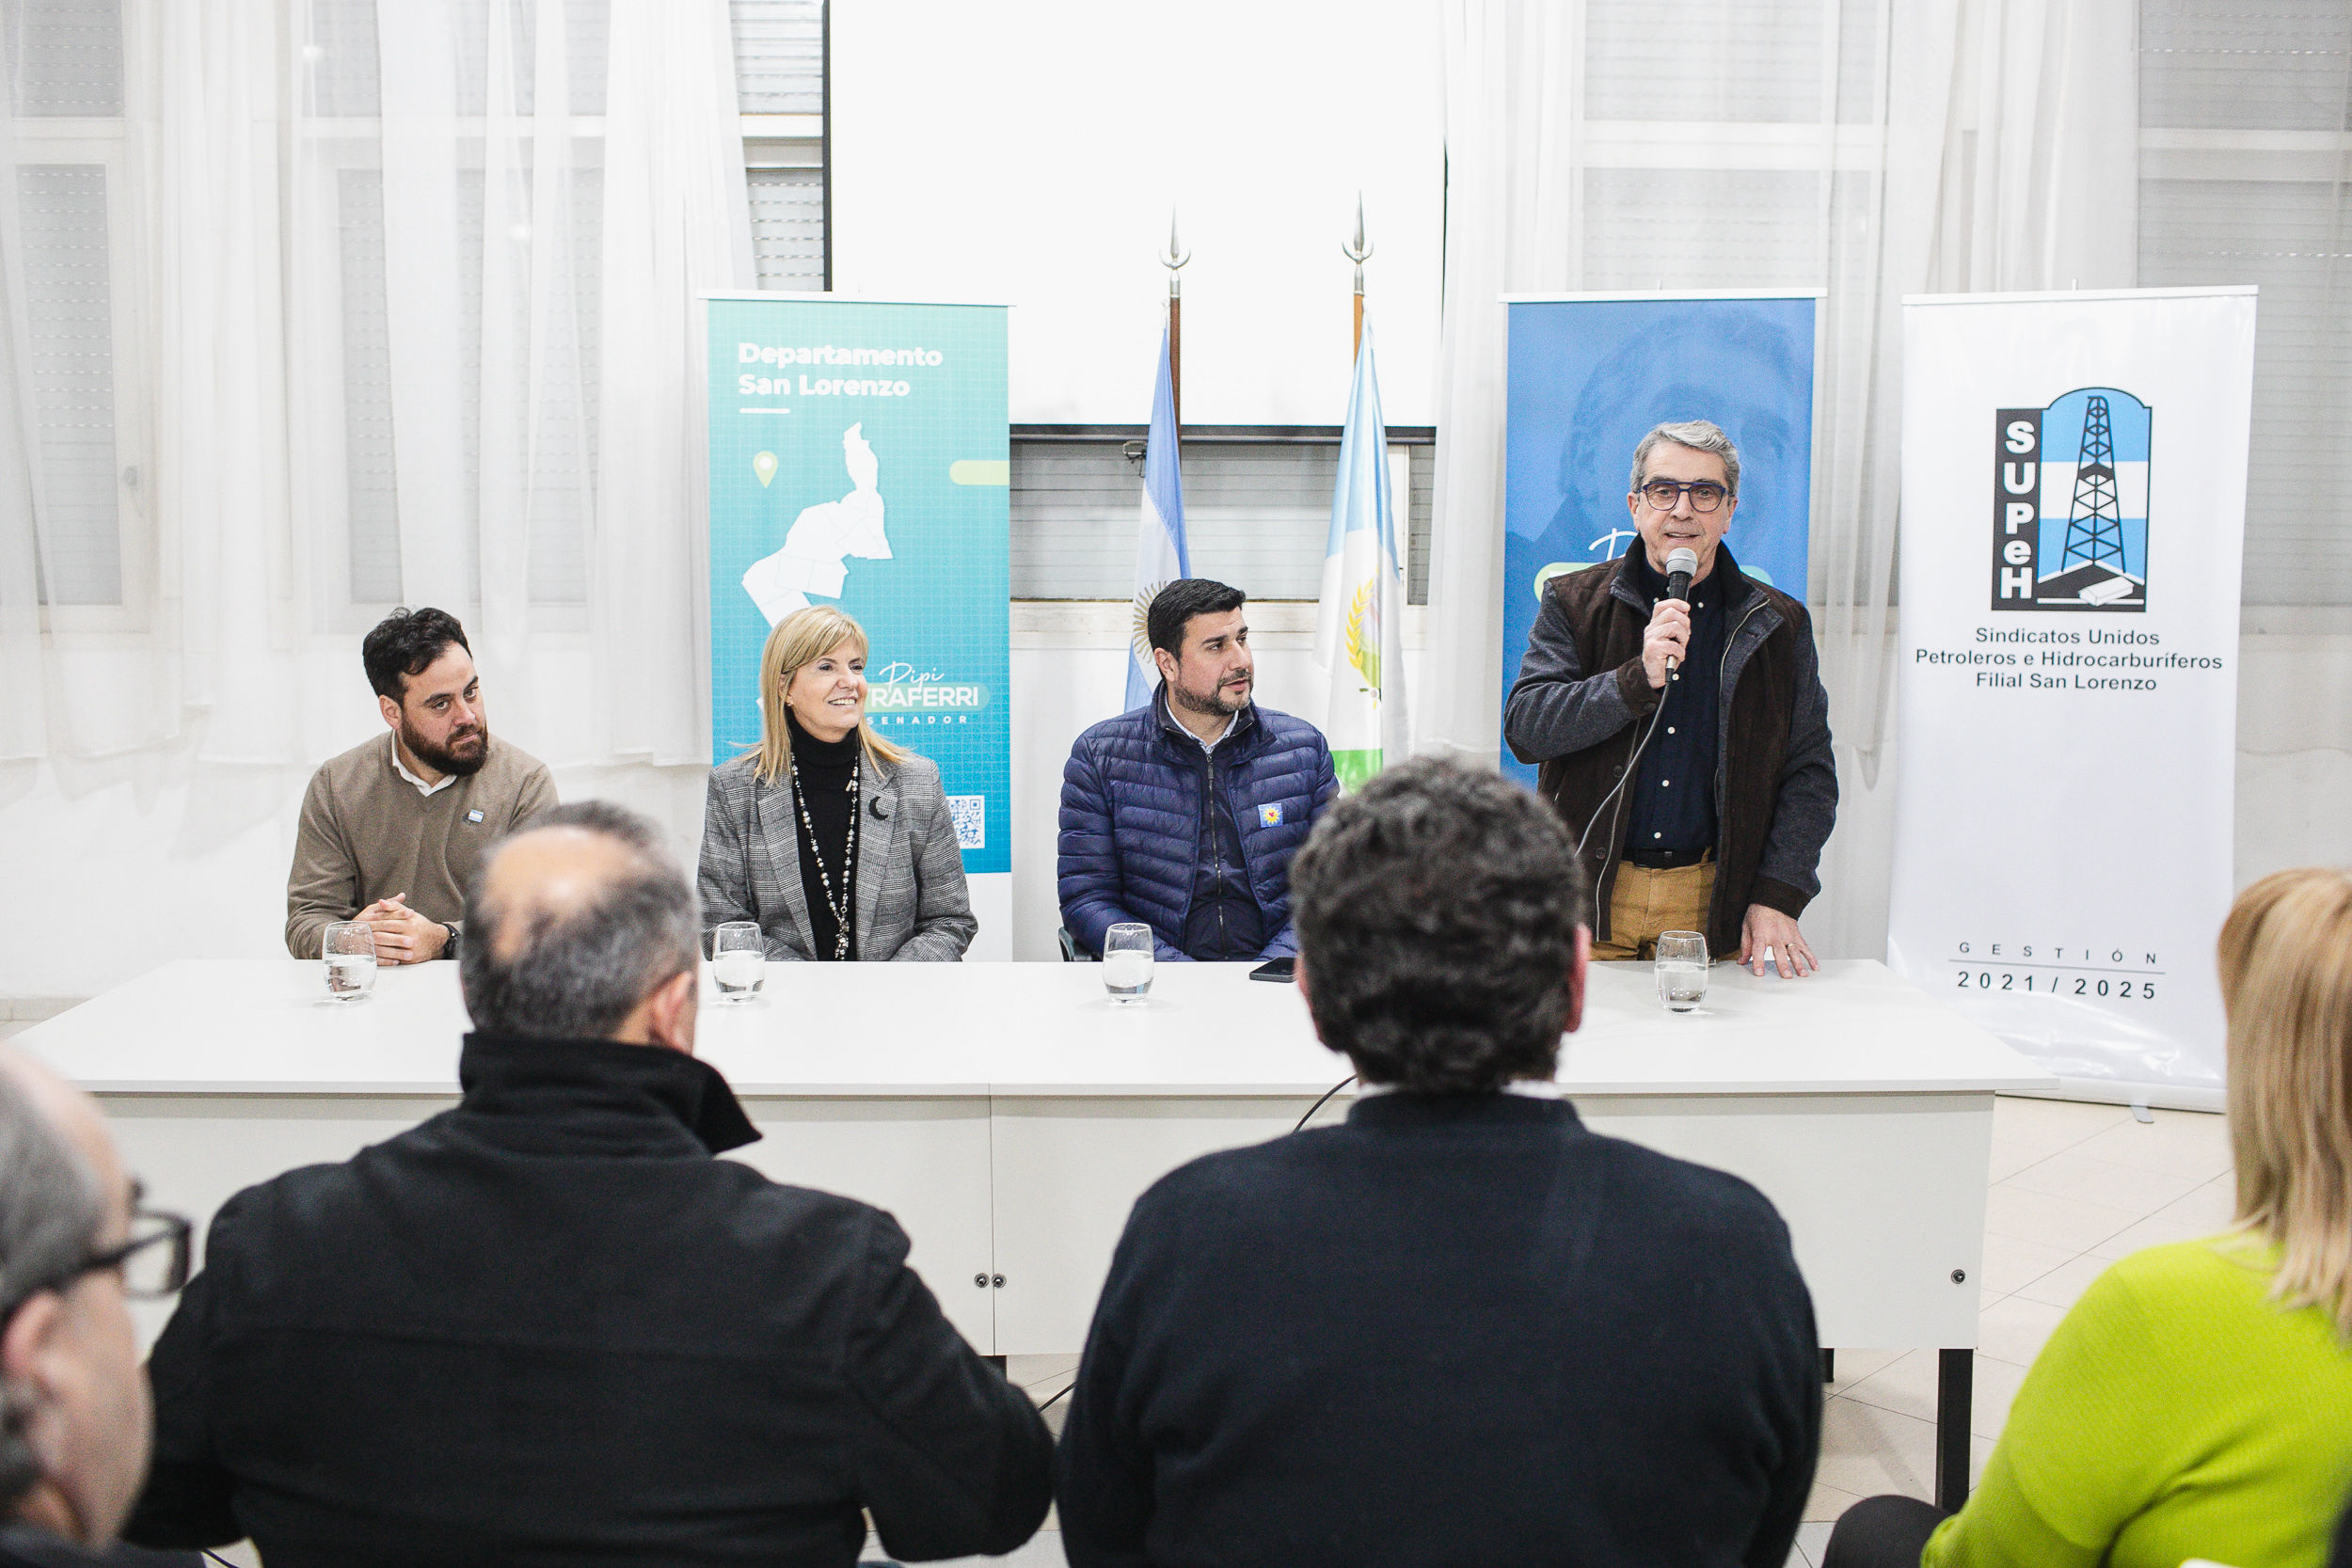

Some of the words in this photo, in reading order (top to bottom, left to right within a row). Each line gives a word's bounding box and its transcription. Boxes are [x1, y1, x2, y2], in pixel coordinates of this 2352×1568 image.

[738, 341, 944, 369] Departamento
[738, 373, 791, 395] San
[798, 374, 911, 397] Lorenzo
[2000, 420, 2036, 599] SUPeH
[1975, 627, 2081, 644] Sindicatos
[2088, 629, 2161, 645] Unidos
[1915, 649, 2017, 666] Petroleros
[2024, 655, 2034, 666] e
[2042, 650, 2223, 670] Hidrocarburíferos
[878, 660, 946, 695] Pipi
[1976, 673, 2023, 688] Filial
[2029, 673, 2068, 689] San
[2074, 673, 2158, 691] Lorenzo
[867, 686, 979, 708] RAFERRI
[866, 715, 968, 725] SENADOR
[1958, 941, 2157, 964] GESTIÓN
